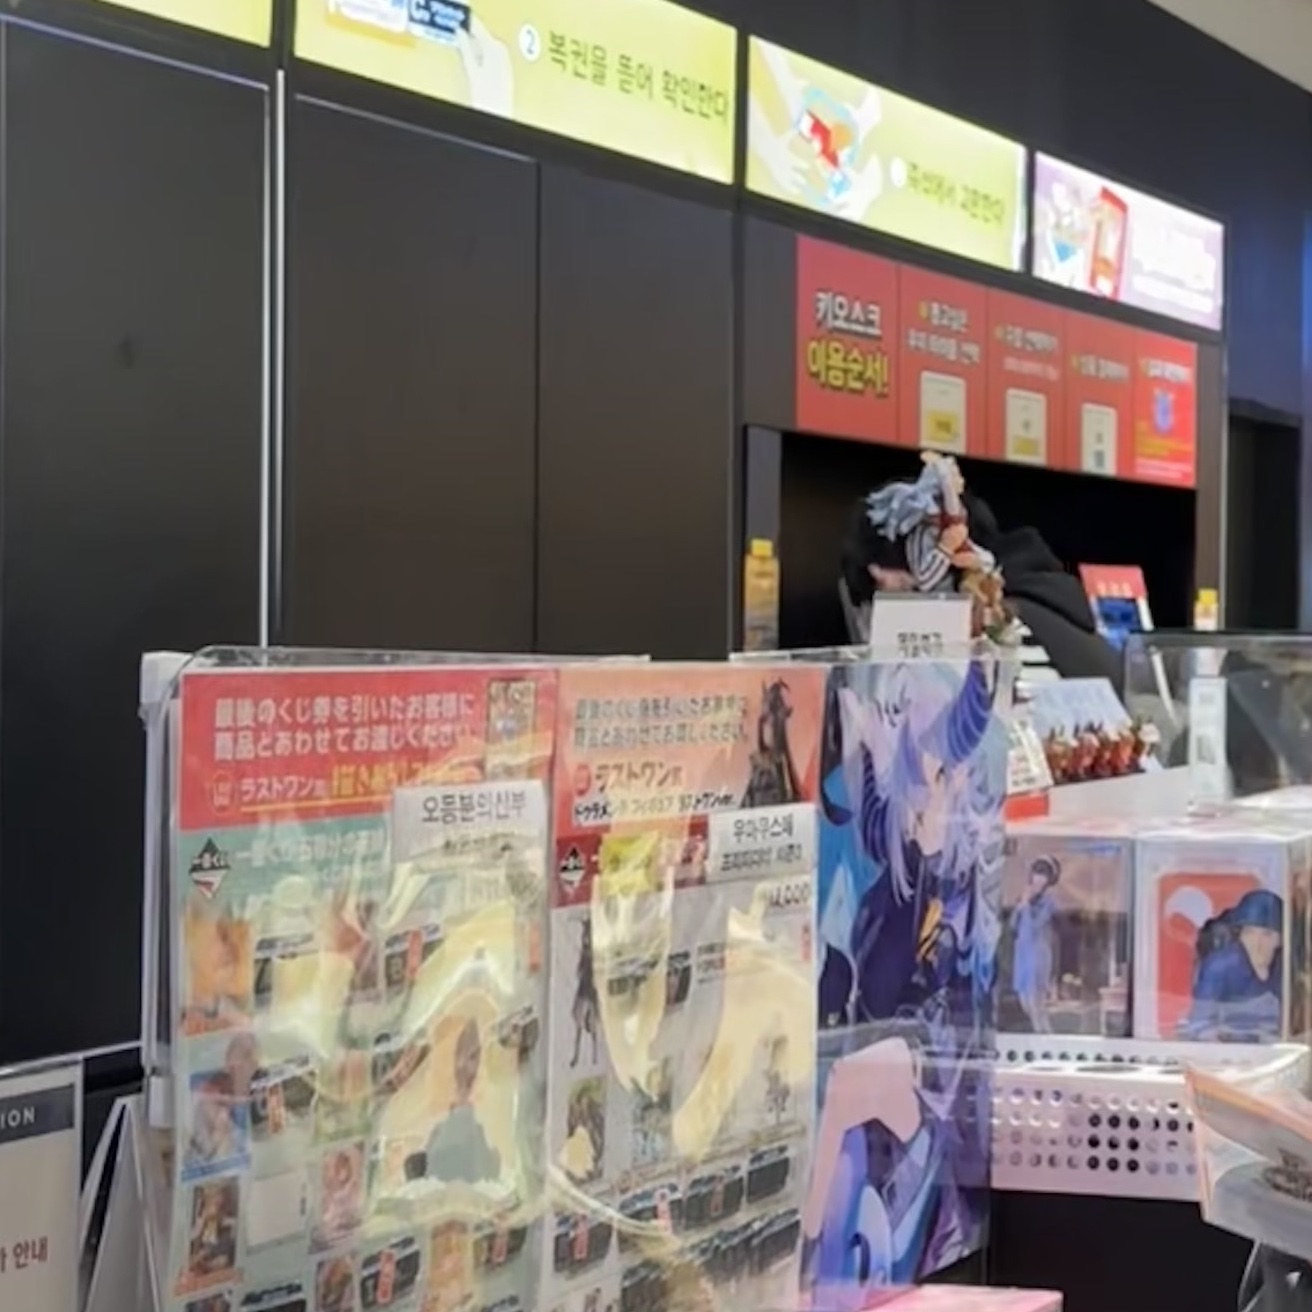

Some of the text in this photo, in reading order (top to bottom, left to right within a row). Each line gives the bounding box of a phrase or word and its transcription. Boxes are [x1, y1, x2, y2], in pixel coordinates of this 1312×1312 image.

[816, 292, 882, 336] 키오스크
[807, 341, 889, 394] 이용순서!
[13, 1236, 48, 1269] 안내
